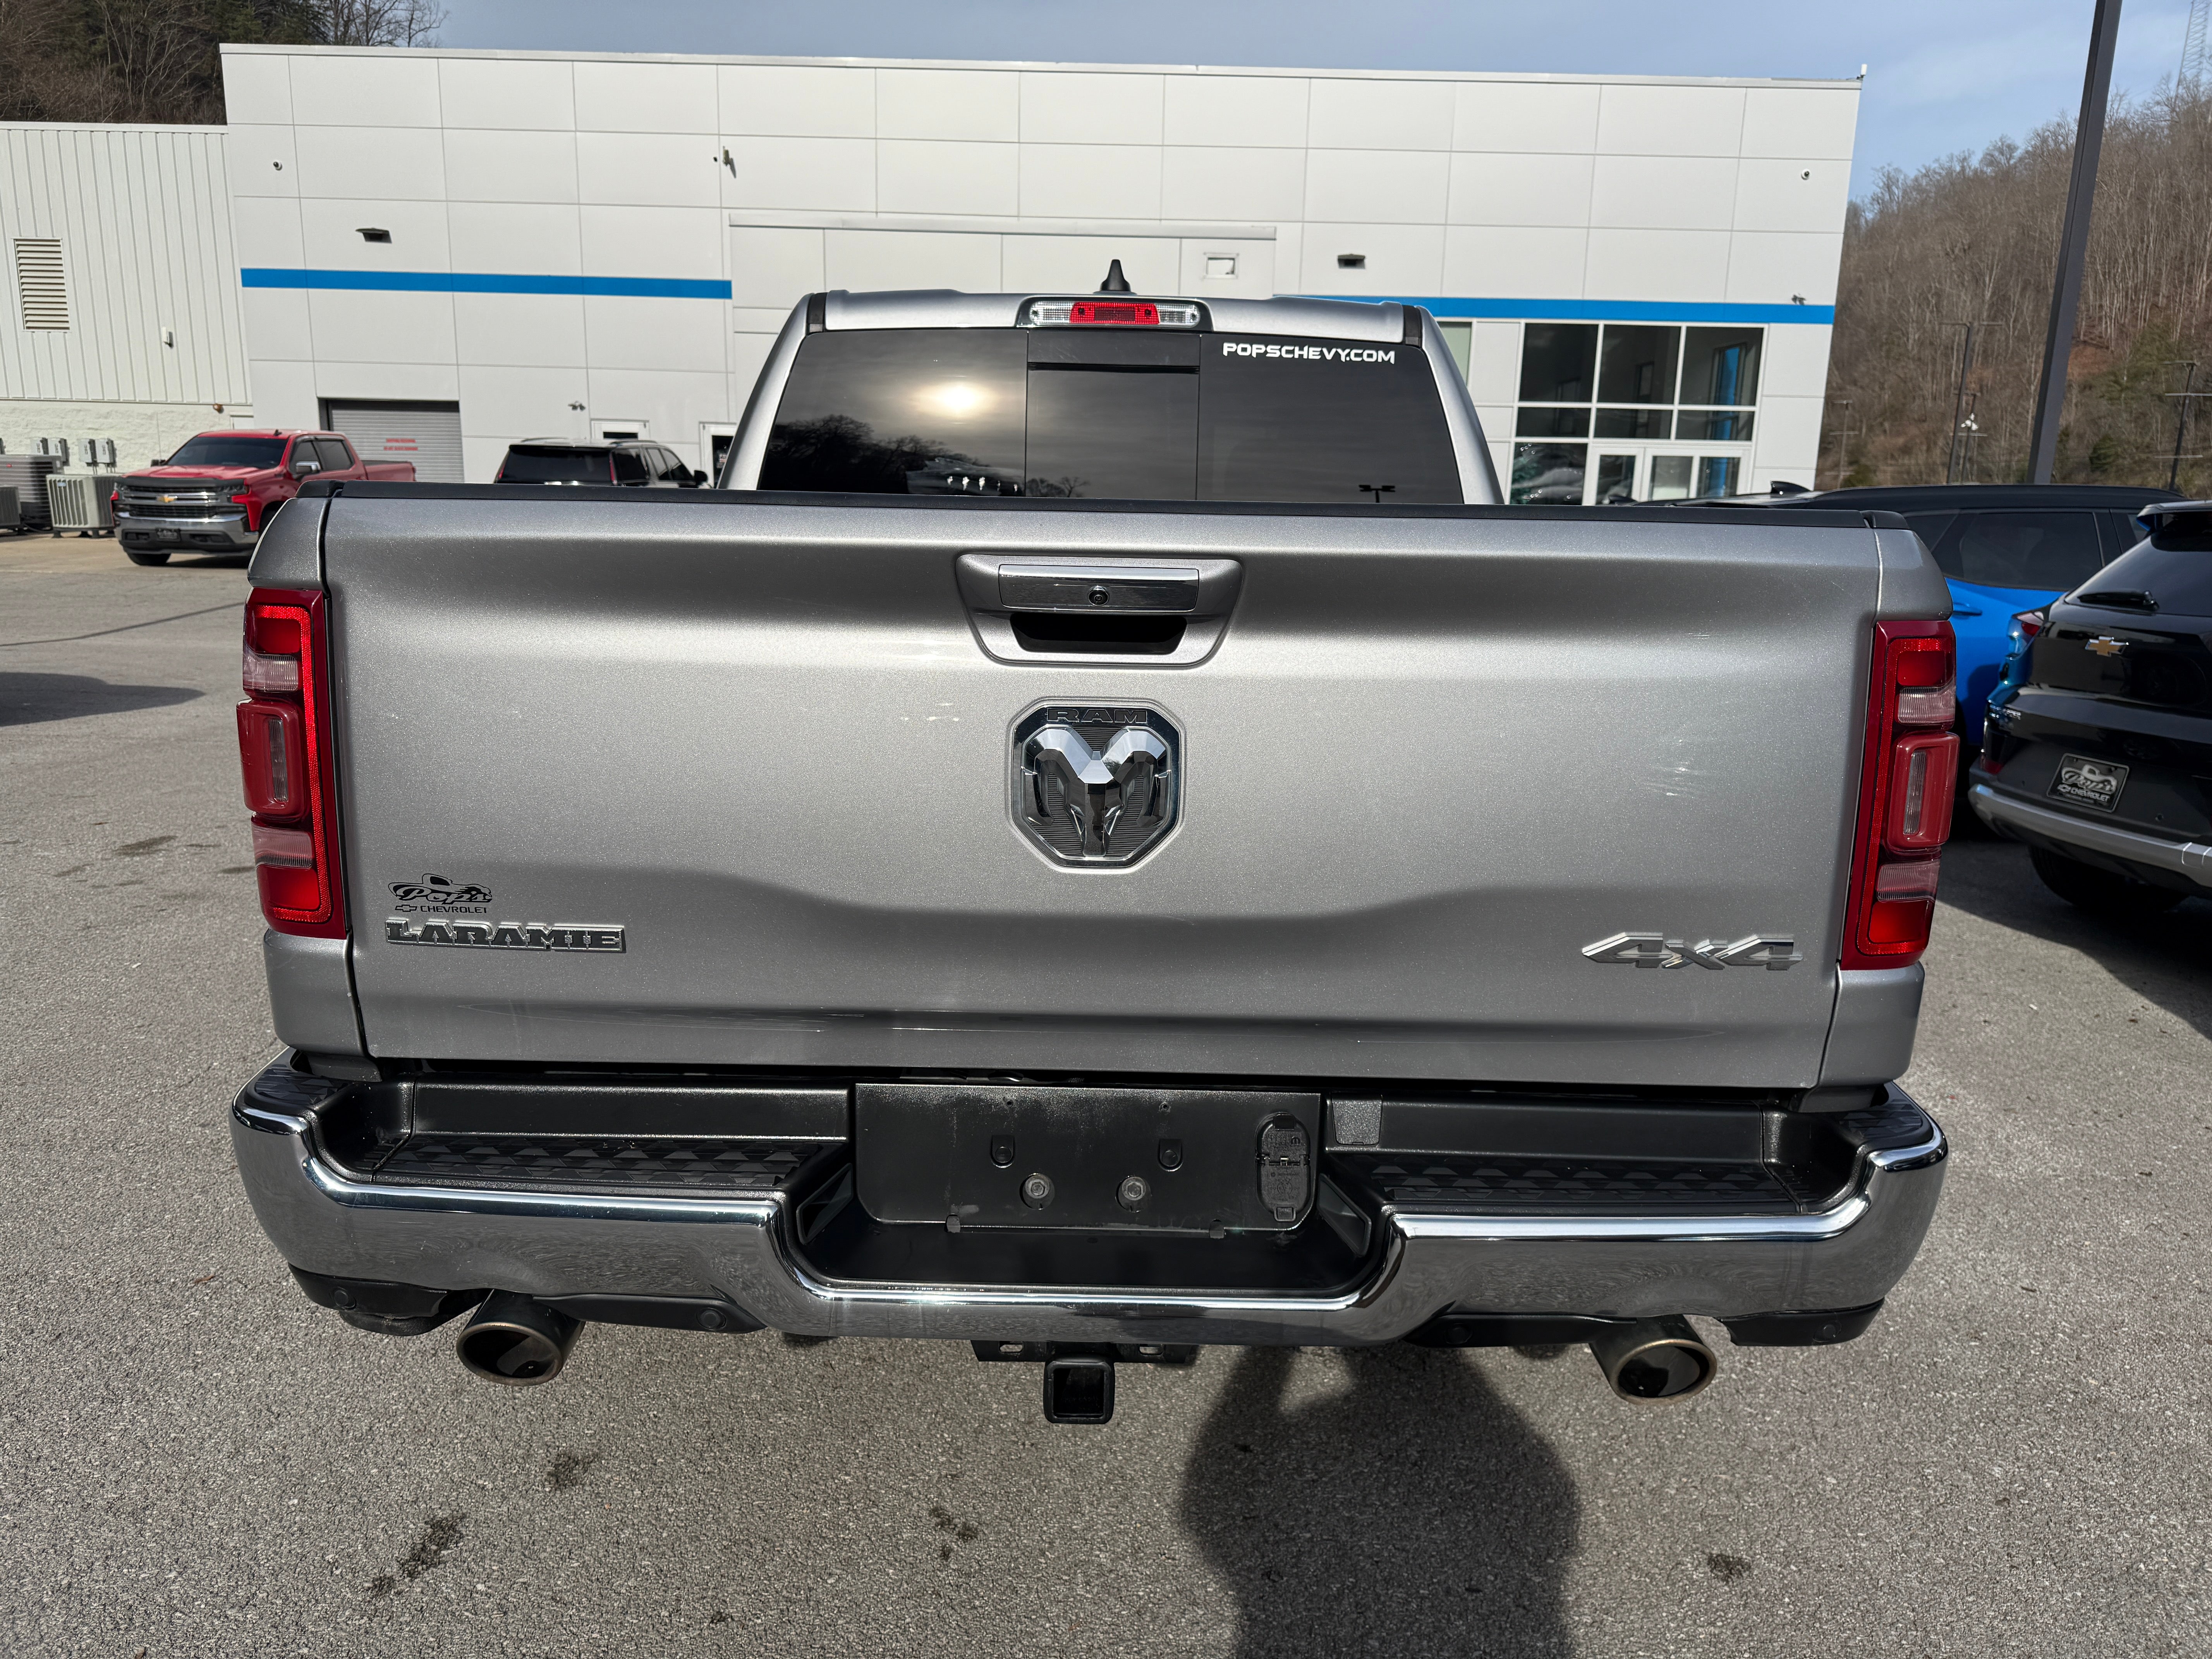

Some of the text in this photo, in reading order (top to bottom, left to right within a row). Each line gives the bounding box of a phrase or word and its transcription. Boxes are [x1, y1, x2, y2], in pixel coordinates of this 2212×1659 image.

[1223, 342, 1395, 364] POPSCHEVY.COM
[1046, 708, 1147, 723] RAM
[2070, 787, 2111, 802] CHEVROLET
[420, 905, 488, 914] CHEVROLET
[385, 918, 627, 953] LARAMIE
